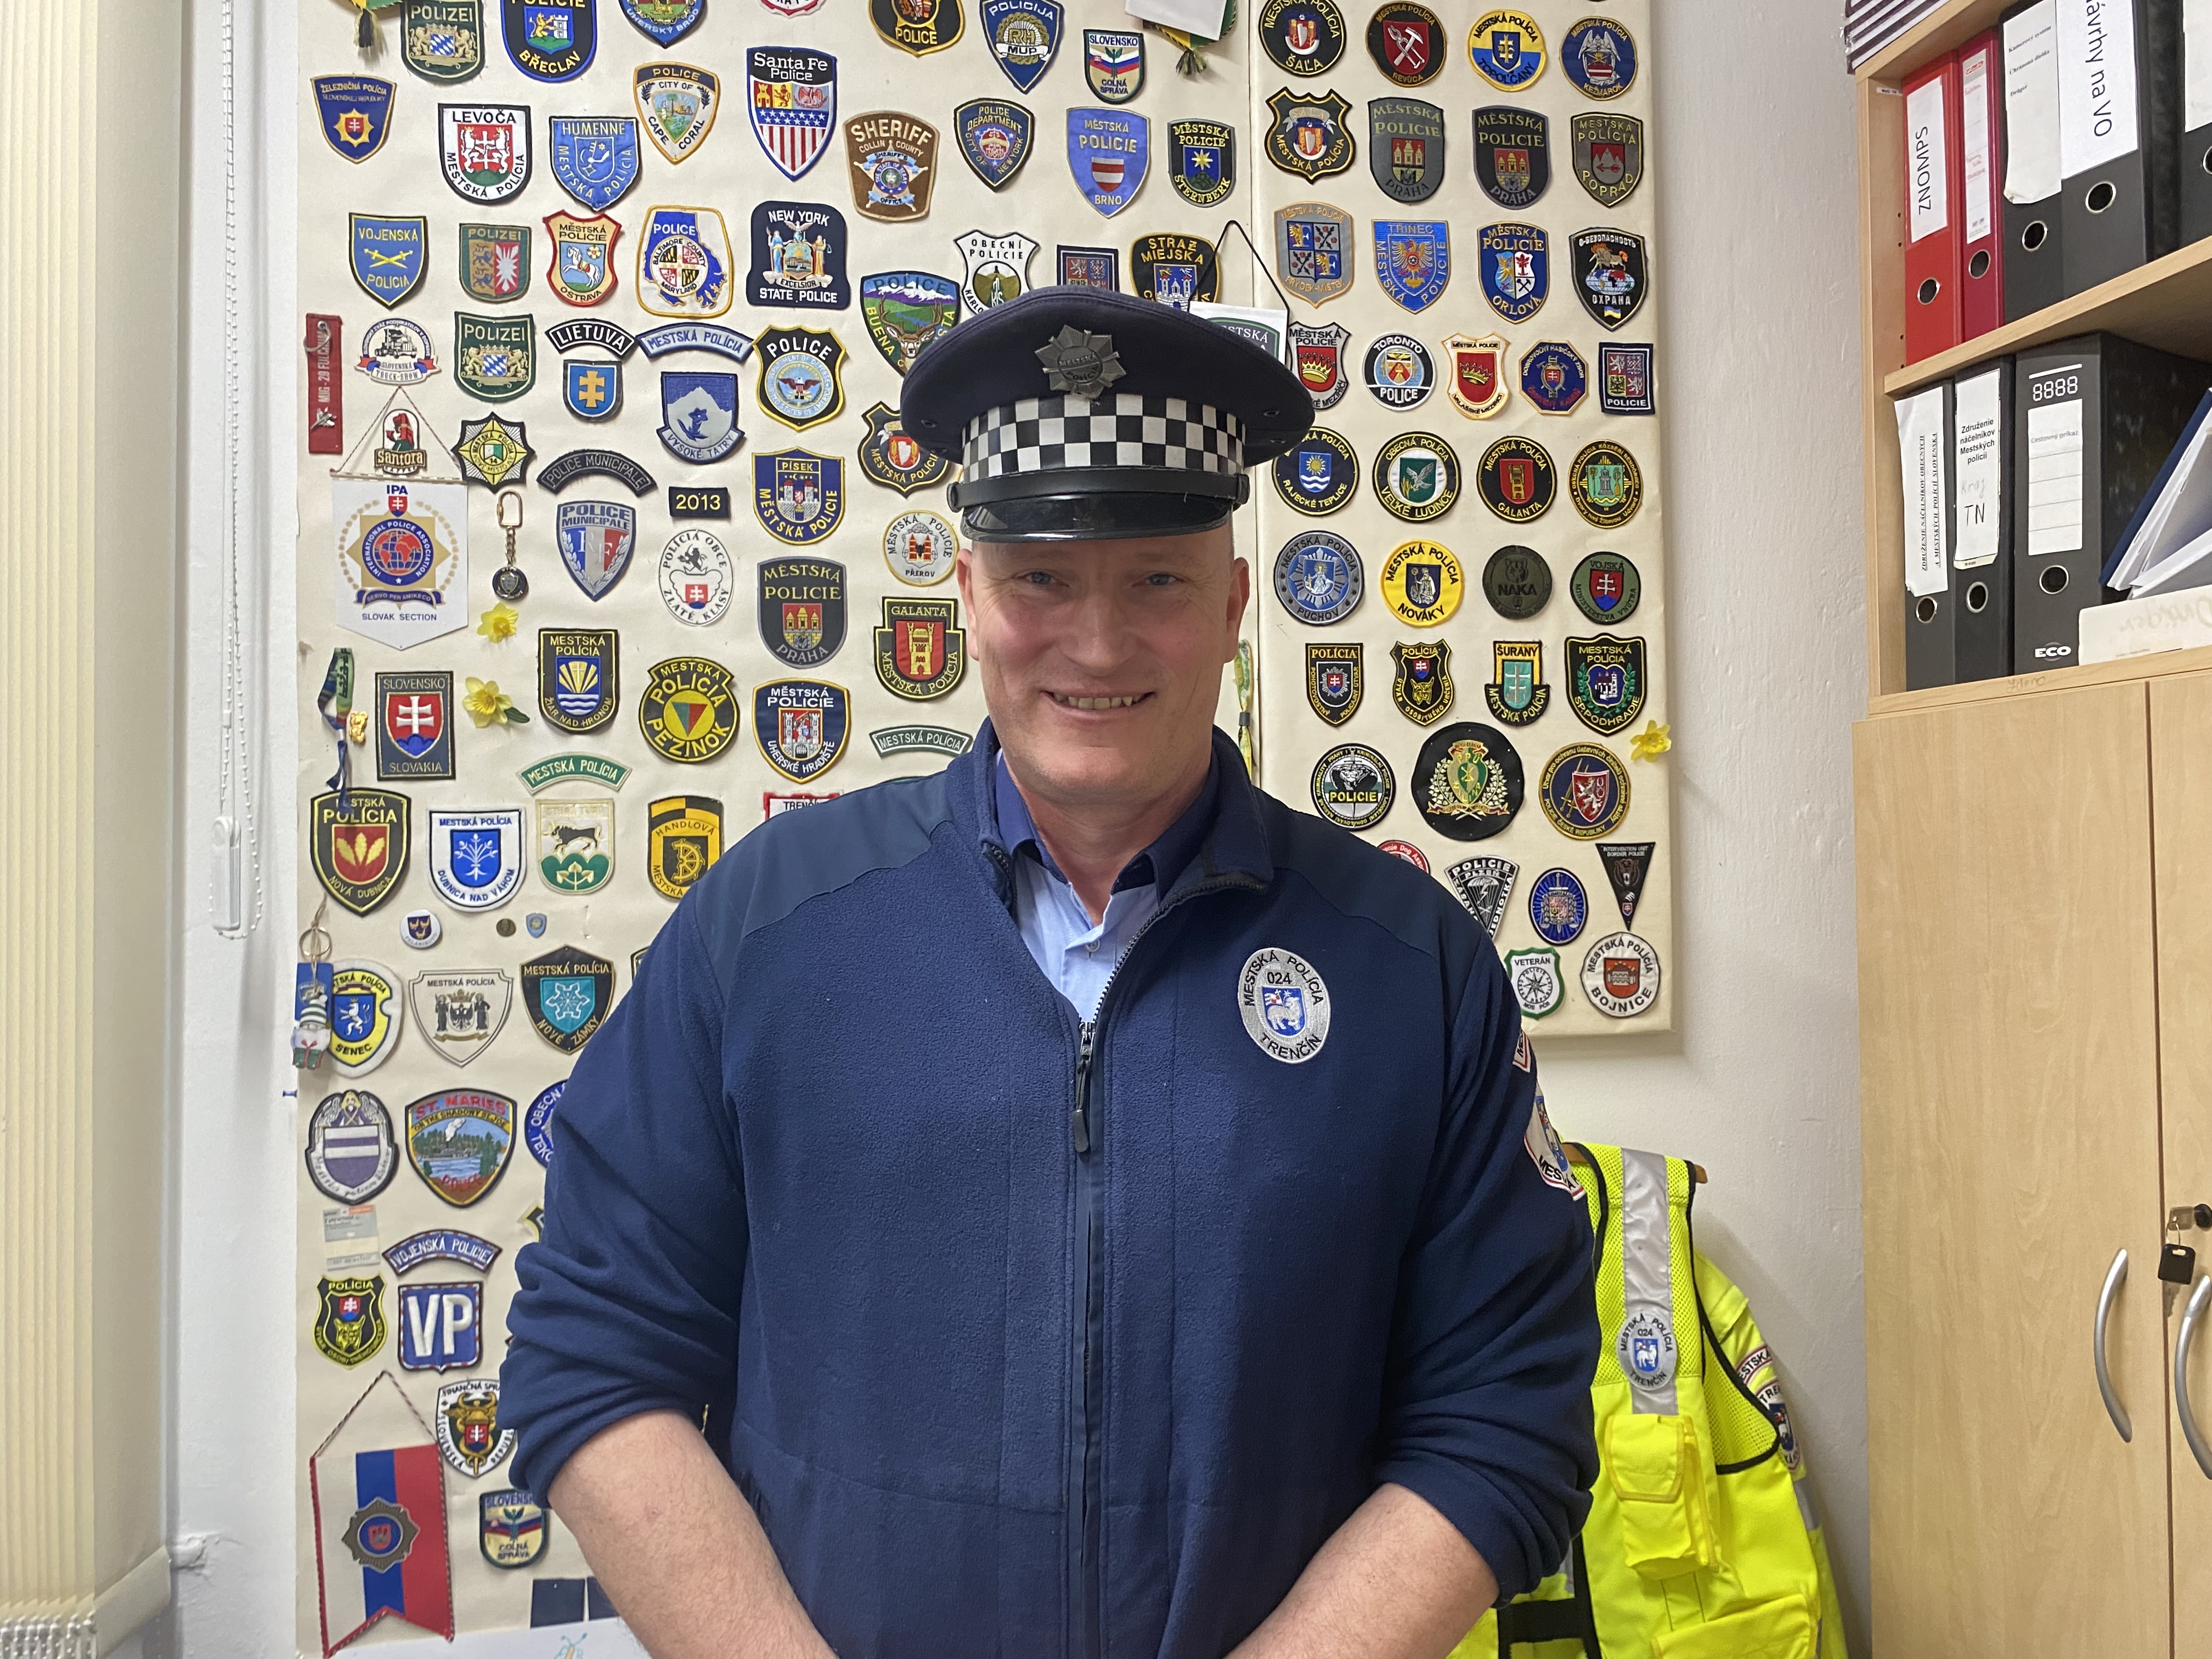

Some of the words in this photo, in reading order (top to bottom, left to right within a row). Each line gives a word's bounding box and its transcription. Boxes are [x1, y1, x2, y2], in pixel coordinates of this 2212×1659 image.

[410, 5, 473, 22] POLIZEI
[989, 1, 1054, 21] POLICIJA
[1474, 12, 1507, 38] MESTSKÁ
[1509, 16, 1538, 43] POLÍCIA
[2085, 0, 2108, 64] ávrhy
[1089, 35, 1138, 46] SLOVENSKO
[519, 49, 580, 74] BŘECLAV
[754, 53, 805, 70] Santa
[808, 58, 827, 71] Fe
[1285, 54, 1323, 72] ŠAĽA
[770, 69, 812, 81] Police
[658, 81, 678, 89] CITY
[681, 82, 693, 90] OF
[2091, 71, 2106, 99] na
[453, 110, 516, 124] LEVOČA
[967, 115, 1022, 134] DEPARTMENT
[2093, 100, 2112, 137] VO
[648, 116, 669, 145] CAPE
[679, 118, 705, 150] CORAL
[850, 119, 932, 145] SHERIFF
[1374, 122, 1440, 137] POLICIE
[1578, 128, 1636, 145] POLÍCIA
[859, 140, 886, 153] COLLIN
[896, 141, 924, 157] COUNTY
[1178, 135, 1225, 147] POLICIE
[1915, 126, 1932, 216] ZNOMPS
[1173, 175, 1231, 204] ŠTERNBERK
[1582, 170, 1634, 197] POPRAD
[1094, 194, 1122, 205] BRNO
[769, 211, 794, 224] NEW
[798, 211, 830, 227] YORK
[468, 228, 521, 241] POLIZEI
[653, 239, 684, 266] BALTIMORE
[687, 241, 706, 267] COUNTY
[971, 240, 1022, 249] OBECNÍ
[1483, 238, 1544, 251] POLICIE
[1141, 249, 1204, 265] MIEJSKA
[661, 281, 697, 295] MARYLAND
[780, 279, 817, 289] EXCELSIOR
[560, 286, 602, 303] OSTRAVA
[759, 289, 793, 301] STATE
[799, 290, 837, 303] POLICE
[1593, 295, 1630, 305] ОХРАНА
[866, 306, 894, 356] BUENA
[1290, 328, 1341, 338] MĚSTSKÁ
[556, 329, 625, 352] LIETUVA
[1296, 337, 1338, 346] POLICIE
[1374, 335, 1424, 354] TORONTO
[2032, 375, 2078, 402] 8888
[1962, 418, 1994, 435] Združenie
[1960, 429, 1995, 445] náčelníkov
[1321, 433, 1350, 460] POLÍCIA
[1385, 437, 1416, 461] OBECNÁ
[1420, 439, 1449, 461] POLÍCIA
[1960, 439, 1995, 455] Mestských
[376, 450, 424, 466] Santora
[782, 461, 813, 471] PÍSEK
[871, 449, 906, 483] MESTSKÁ
[546, 458, 582, 483] POLICE
[585, 453, 646, 488] MUNICIPALE
[386, 485, 408, 494] IPA
[1283, 479, 1316, 507] RAJECKÉ
[1319, 483, 1347, 507] TEPLICE
[676, 494, 720, 510] 2013
[1497, 501, 1542, 518] GALANTA
[562, 517, 629, 530] MUNICIPALE
[1964, 503, 1985, 527] TN
[365, 524, 386, 578] INTERNATIONAL
[387, 521, 414, 531] POLICE
[414, 524, 432, 578] ASSOCIATION
[663, 529, 699, 569] POLÍCIA
[705, 537, 728, 568] OBCE
[1282, 535, 1321, 569] MESTSKÁ
[1327, 539, 1357, 572] POLÍCIA
[763, 564, 840, 583] MĚSTSKÁ
[906, 569, 935, 577] PŘEROV
[1590, 560, 1624, 570] VOJSKÁ
[764, 587, 842, 600] POLICIE
[1498, 584, 1537, 596] NAKA
[664, 589, 696, 621] ZLATÉ
[704, 589, 729, 624] KLASY
[891, 607, 948, 617] GALANTA
[1397, 603, 1445, 622] NOVÁKY
[550, 634, 605, 647] MESTSKÁ
[556, 645, 600, 657] POLÍCIA
[775, 644, 828, 663] PRAHA
[1311, 648, 1357, 658] POLÍCIA
[1579, 645, 1632, 654] MESTSKÁ
[2034, 644, 2072, 658] ECO
[1587, 654, 1625, 664] POLÍCIA
[882, 651, 923, 696] MESTSKÁ
[928, 651, 957, 693] POLÍCIA
[383, 678, 445, 690] SLOVENSKO
[646, 718, 731, 757] PEZINOK
[390, 761, 442, 773] SLOVAKIA
[1330, 791, 1377, 803] POLICIE
[323, 806, 397, 823] POLÍCIA
[440, 817, 478, 826] MESTSKÁ
[481, 816, 512, 826] POLÍCIA
[655, 821, 714, 837] HANDLOVÁ
[330, 876, 352, 896] NOVÁ
[358, 877, 392, 899] DUBNICA
[439, 870, 466, 901] DUBNICA
[470, 893, 489, 902] NAD
[493, 869, 515, 897] VÁHOM
[1491, 876, 1513, 936] JEDNOTKA
[1514, 957, 1550, 967] VETERÁN
[1588, 935, 1624, 972] MESTSKÁ
[1627, 939, 1653, 974] POLÍCIA
[524, 962, 569, 975] MESTSKÁ
[574, 962, 609, 974] POLÍCIA
[361, 974, 386, 995] POLÍCIA
[427, 978, 464, 986] MESTSKÁ
[466, 978, 495, 986] POLÍCIA
[1244, 950, 1279, 1006] MESTSKÁ
[1287, 956, 1323, 1005] POLÍCIA
[1267, 972, 1292, 984] 024
[1591, 987, 1652, 1012] BOJNICE
[537, 1019, 562, 1045] NOVÉ
[574, 1015, 599, 1045] ZÁMKY
[336, 1044, 372, 1056] SENEC
[1261, 1032, 1322, 1059] TRENČÍN
[395, 1235, 445, 1266] VOJENSKÁ
[452, 1238, 492, 1262] POLICIE
[329, 1280, 374, 1291] POLÍCIA
[408, 1294, 473, 1357] VP
[1621, 1313, 1645, 1351] MESTSKÁ
[1651, 1318, 1673, 1352] POLÍCIA
[1630, 1371, 1667, 1387] TRENČÍN
